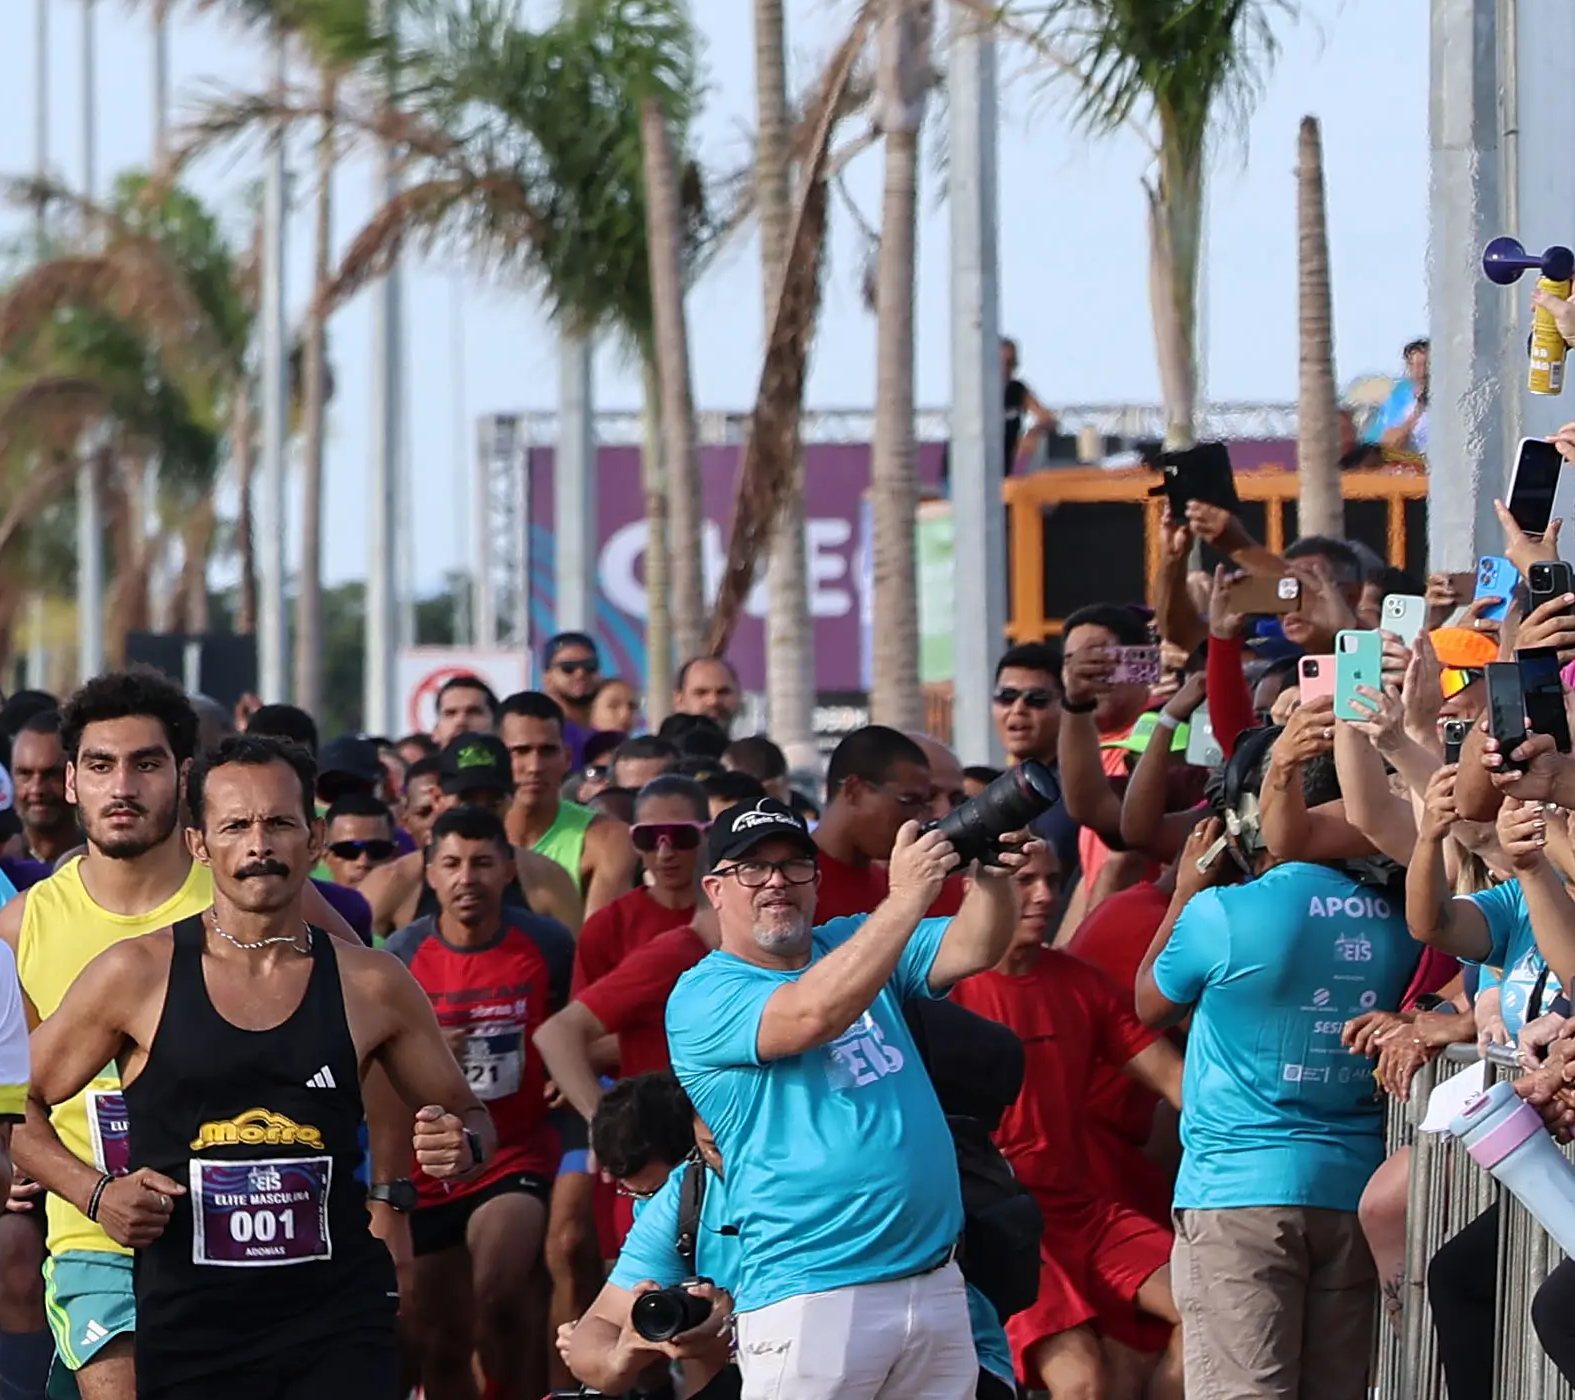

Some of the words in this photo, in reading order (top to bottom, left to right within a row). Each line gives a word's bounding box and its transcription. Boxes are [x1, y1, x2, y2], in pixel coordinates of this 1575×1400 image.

[1309, 896, 1391, 919] APOIO
[463, 1066, 499, 1083] 21
[215, 1194, 247, 1206] ELITE
[250, 1191, 310, 1204] MASCULINA
[230, 1209, 294, 1243] 001
